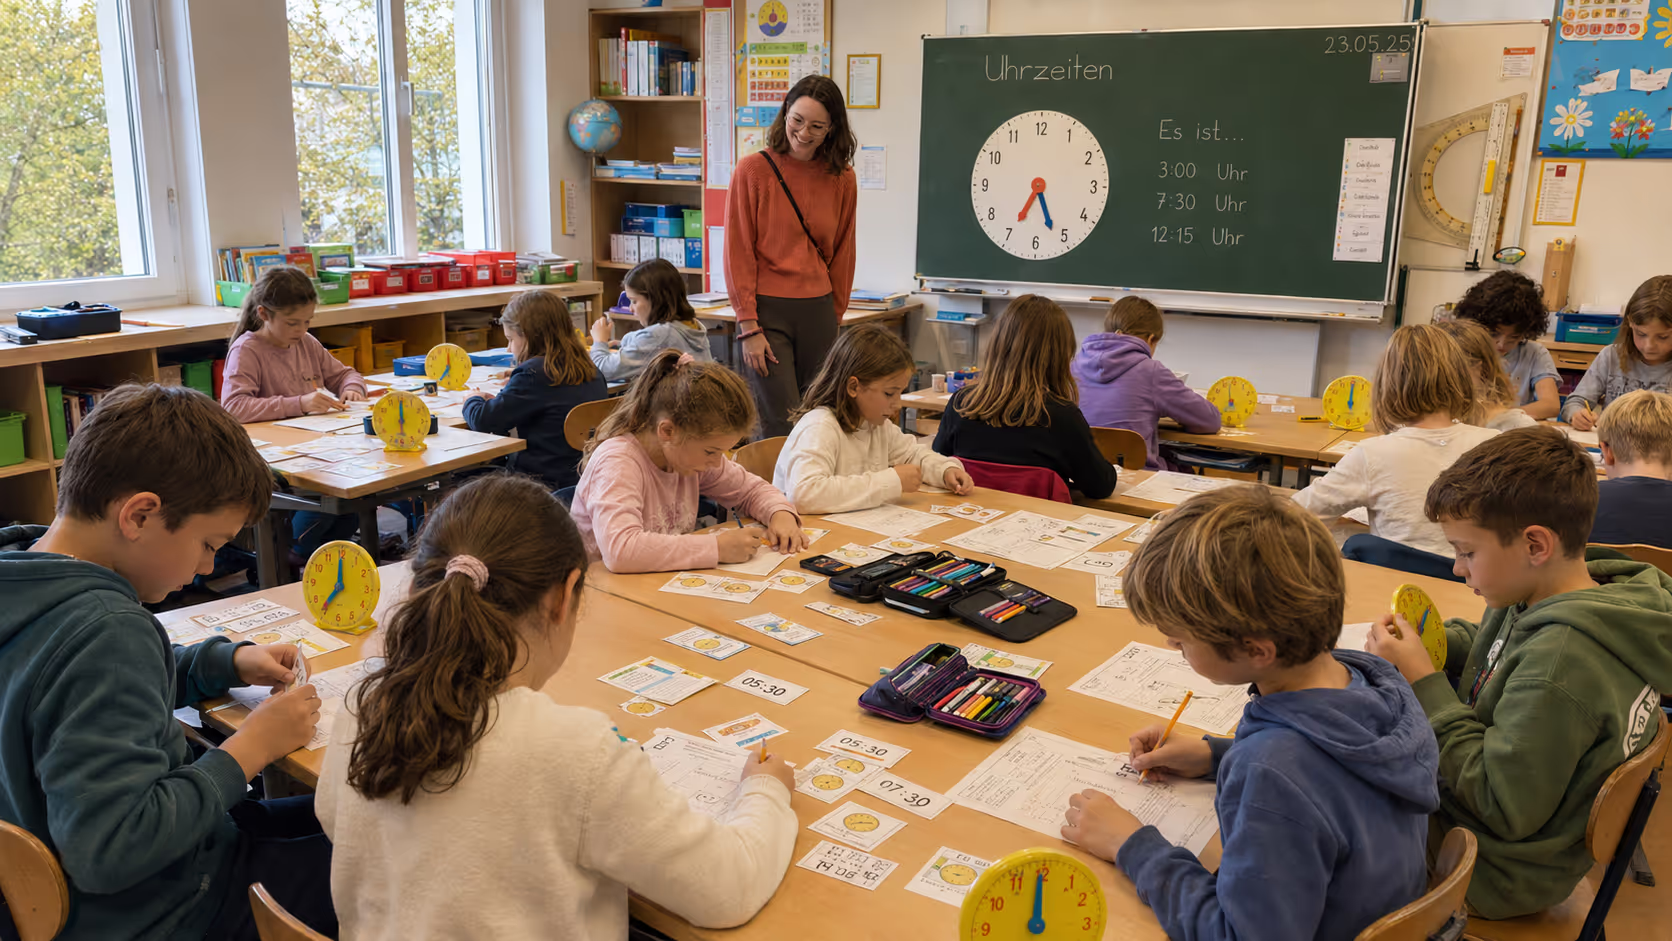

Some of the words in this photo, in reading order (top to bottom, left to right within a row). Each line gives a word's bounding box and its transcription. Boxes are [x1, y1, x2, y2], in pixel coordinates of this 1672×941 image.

[1324, 34, 1411, 54] 23.05.25
[985, 53, 1113, 82] Uhrzeiten
[1008, 129, 1018, 143] 11
[1036, 122, 1048, 136] 12
[1159, 118, 1183, 140] Es
[1196, 119, 1244, 141] ist...
[989, 150, 1001, 165] 10
[1085, 150, 1092, 165] 2
[1158, 160, 1196, 179] 3:00
[1217, 163, 1248, 181] Uhr
[982, 178, 989, 192] 9
[1090, 179, 1098, 194] 3
[1156, 192, 1196, 210] 7:30
[1216, 193, 1247, 212] Uhr
[988, 207, 995, 221] 8
[1079, 207, 1088, 222] 4
[1005, 227, 1013, 241] 7
[1060, 228, 1068, 243] 5
[1151, 226, 1194, 244] 12:15
[1212, 227, 1245, 245] Uhr
[1032, 236, 1039, 250] 6
[325, 553, 332, 562] 11
[315, 564, 323, 573] 10
[361, 569, 366, 578] 2
[310, 578, 316, 587] 9
[364, 585, 370, 594] 3
[313, 595, 319, 603] 8
[335, 614, 341, 622] 6
[741, 677, 787, 697] 05:30
[839, 737, 888, 756] 05:30
[879, 779, 931, 807] 07:30
[1009, 876, 1023, 891] 11
[989, 896, 1005, 911] 10
[1077, 892, 1087, 907] 2
[981, 922, 991, 936] 9
[1082, 917, 1091, 931] 3
